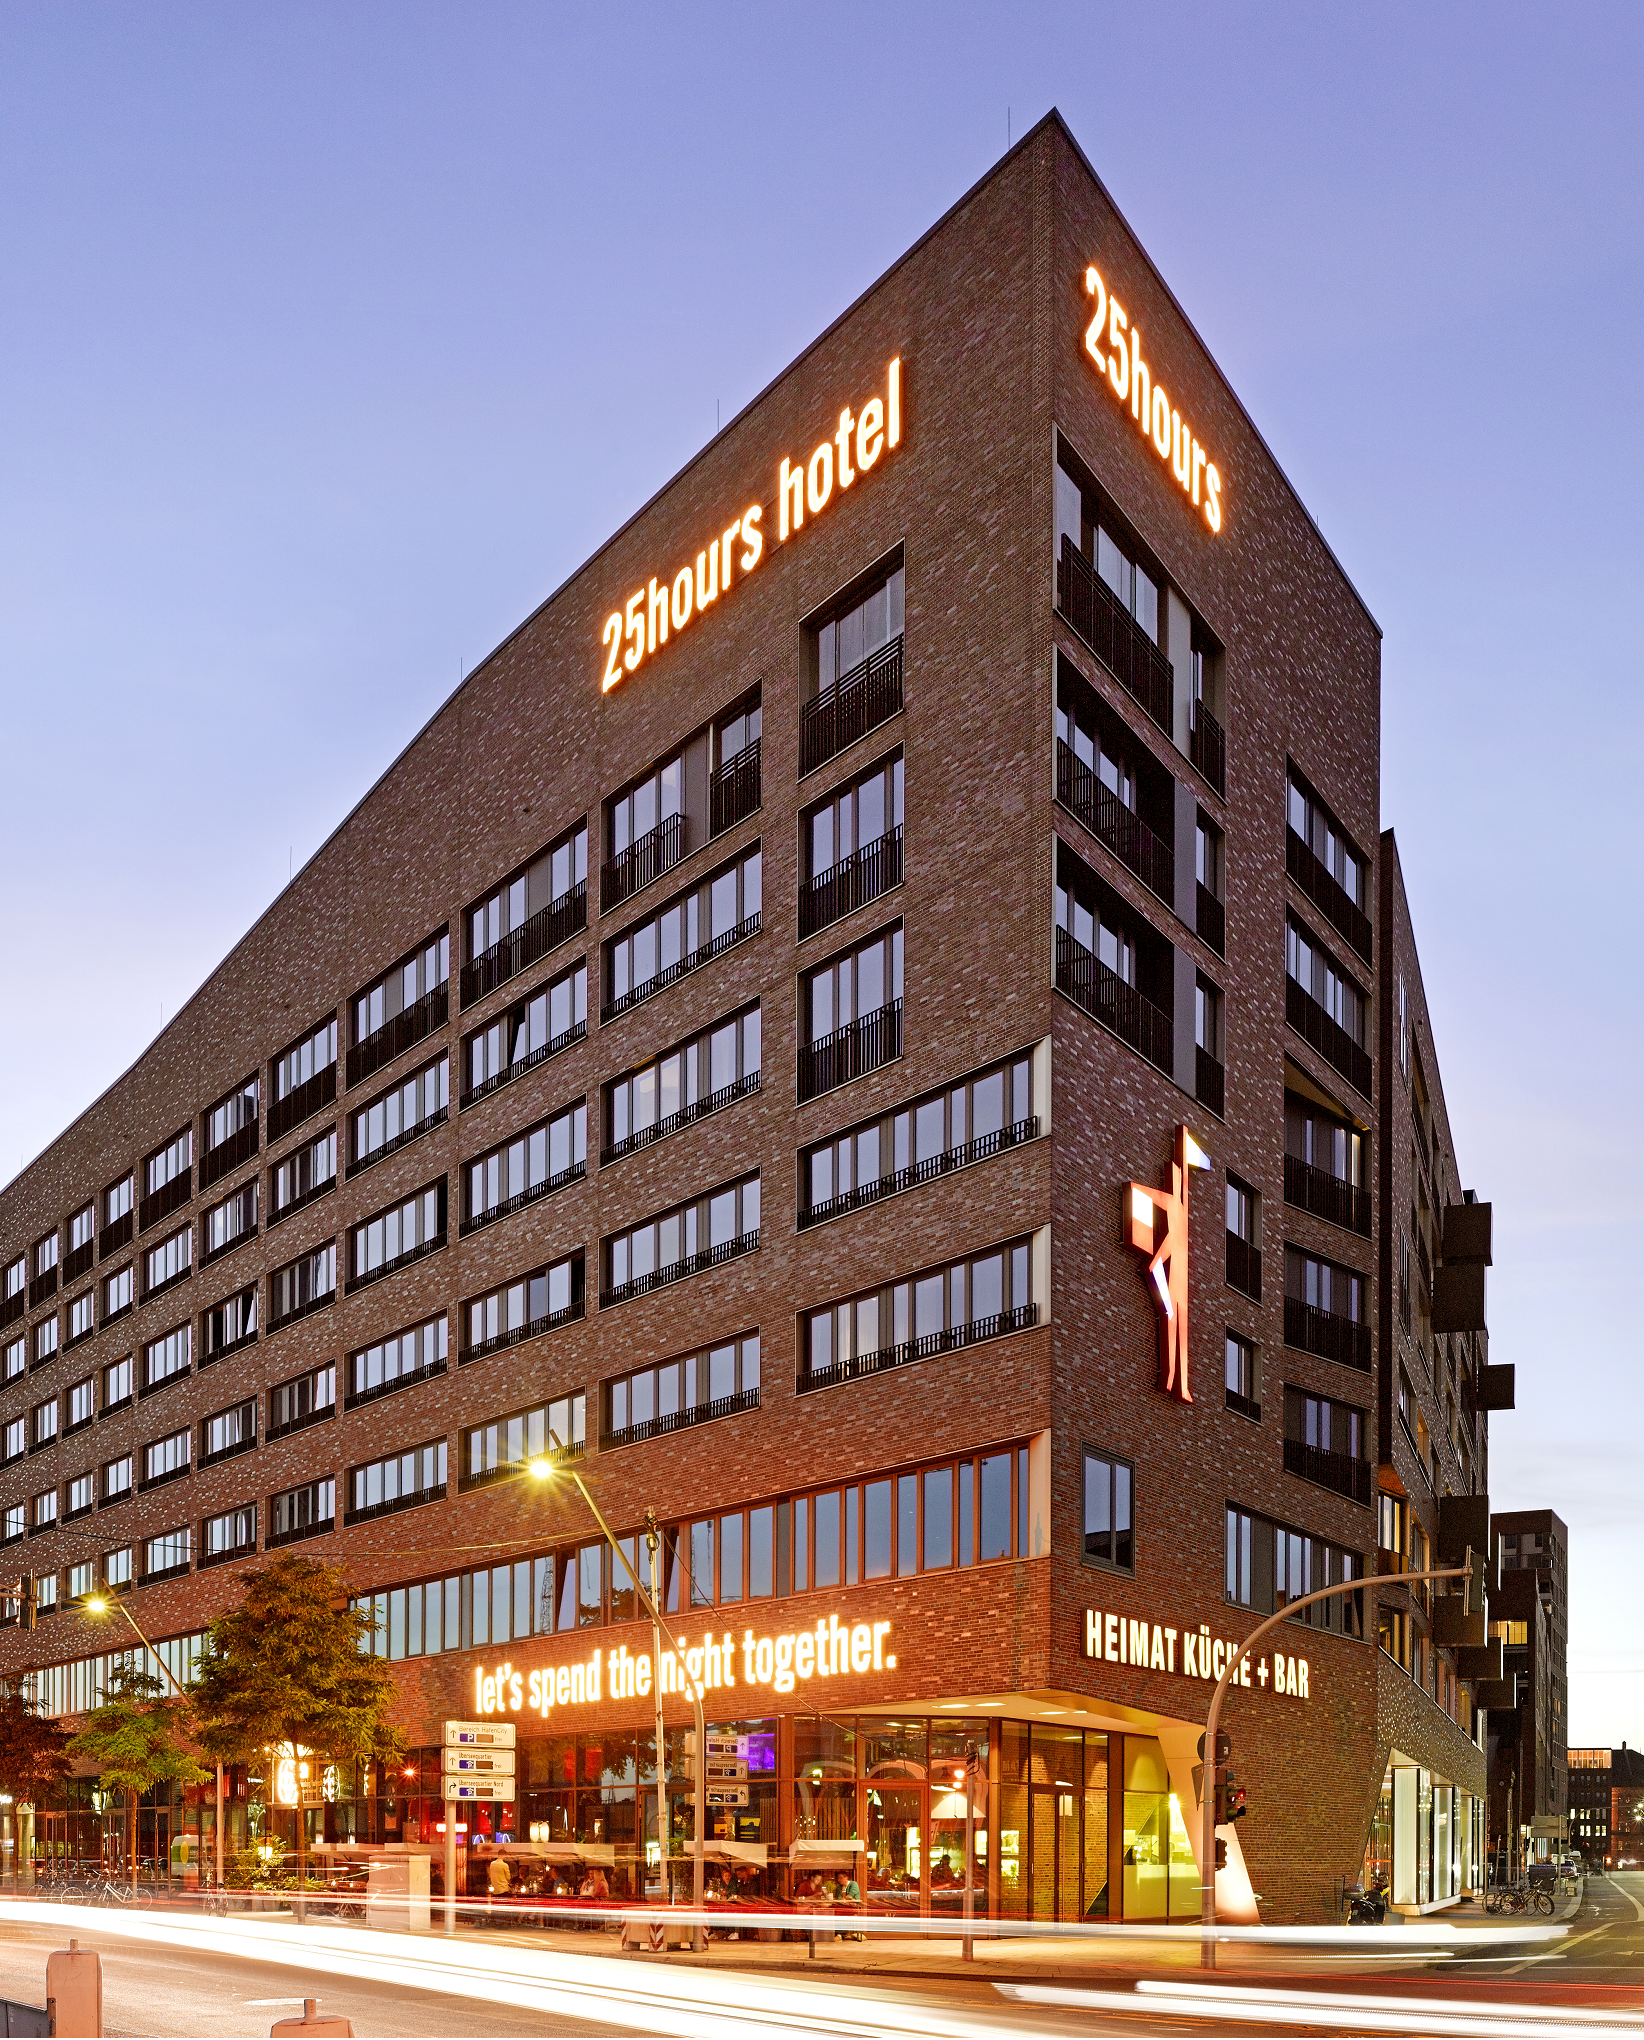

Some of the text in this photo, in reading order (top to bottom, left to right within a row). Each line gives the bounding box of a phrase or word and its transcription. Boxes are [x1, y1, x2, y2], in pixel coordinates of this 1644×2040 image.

[1085, 265, 1221, 533] 25hours
[602, 356, 901, 694] 25hours hotel
[476, 1614, 897, 1718] let's spend the night together.
[1086, 1609, 1178, 1673] HEIMAT
[1184, 1624, 1251, 1688] KÜCHE
[1274, 1652, 1310, 1699] BAR
[459, 1725, 480, 1733] Bereich
